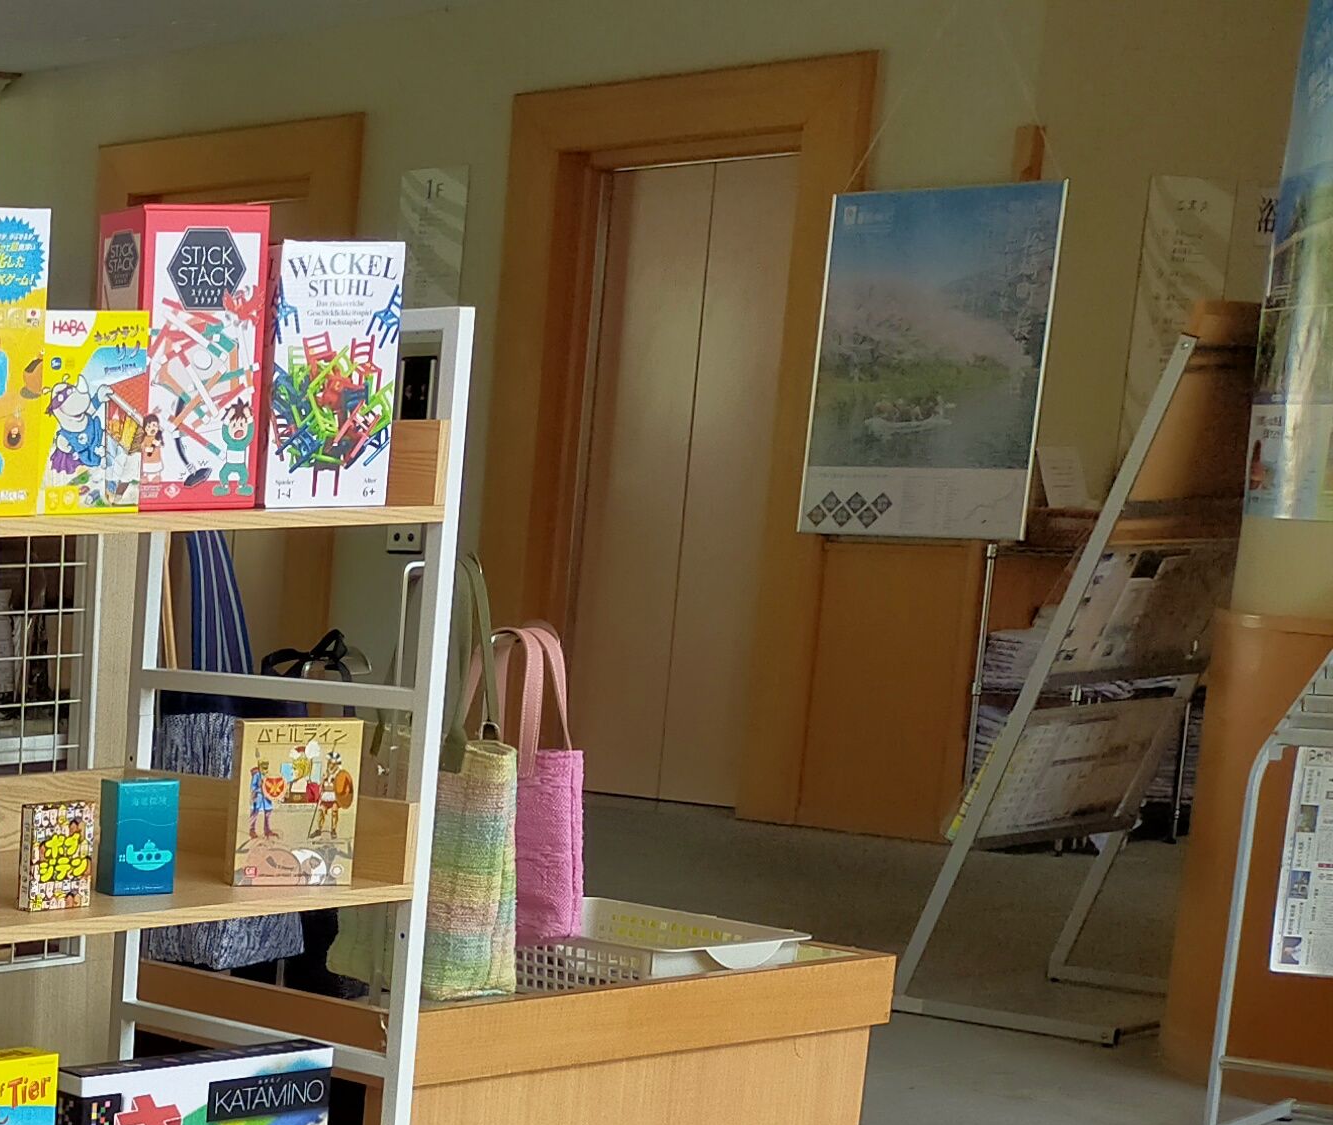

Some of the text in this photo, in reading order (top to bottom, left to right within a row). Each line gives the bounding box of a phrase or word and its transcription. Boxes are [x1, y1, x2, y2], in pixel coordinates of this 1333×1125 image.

[108, 243, 133, 259] STICK
[181, 245, 233, 266] STICK
[108, 258, 136, 273] STACK
[288, 253, 398, 280] WACKEL
[177, 266, 236, 288] STACK
[308, 279, 374, 298] STUHL
[53, 319, 88, 336] HABA
[277, 488, 292, 499] 1-4
[362, 488, 375, 498] 6+
[257, 726, 348, 743] バトルライン
[39, 857, 90, 882] ジテン
[7, 1076, 51, 1109] Tier
[214, 1078, 324, 1113] KATAMINO
